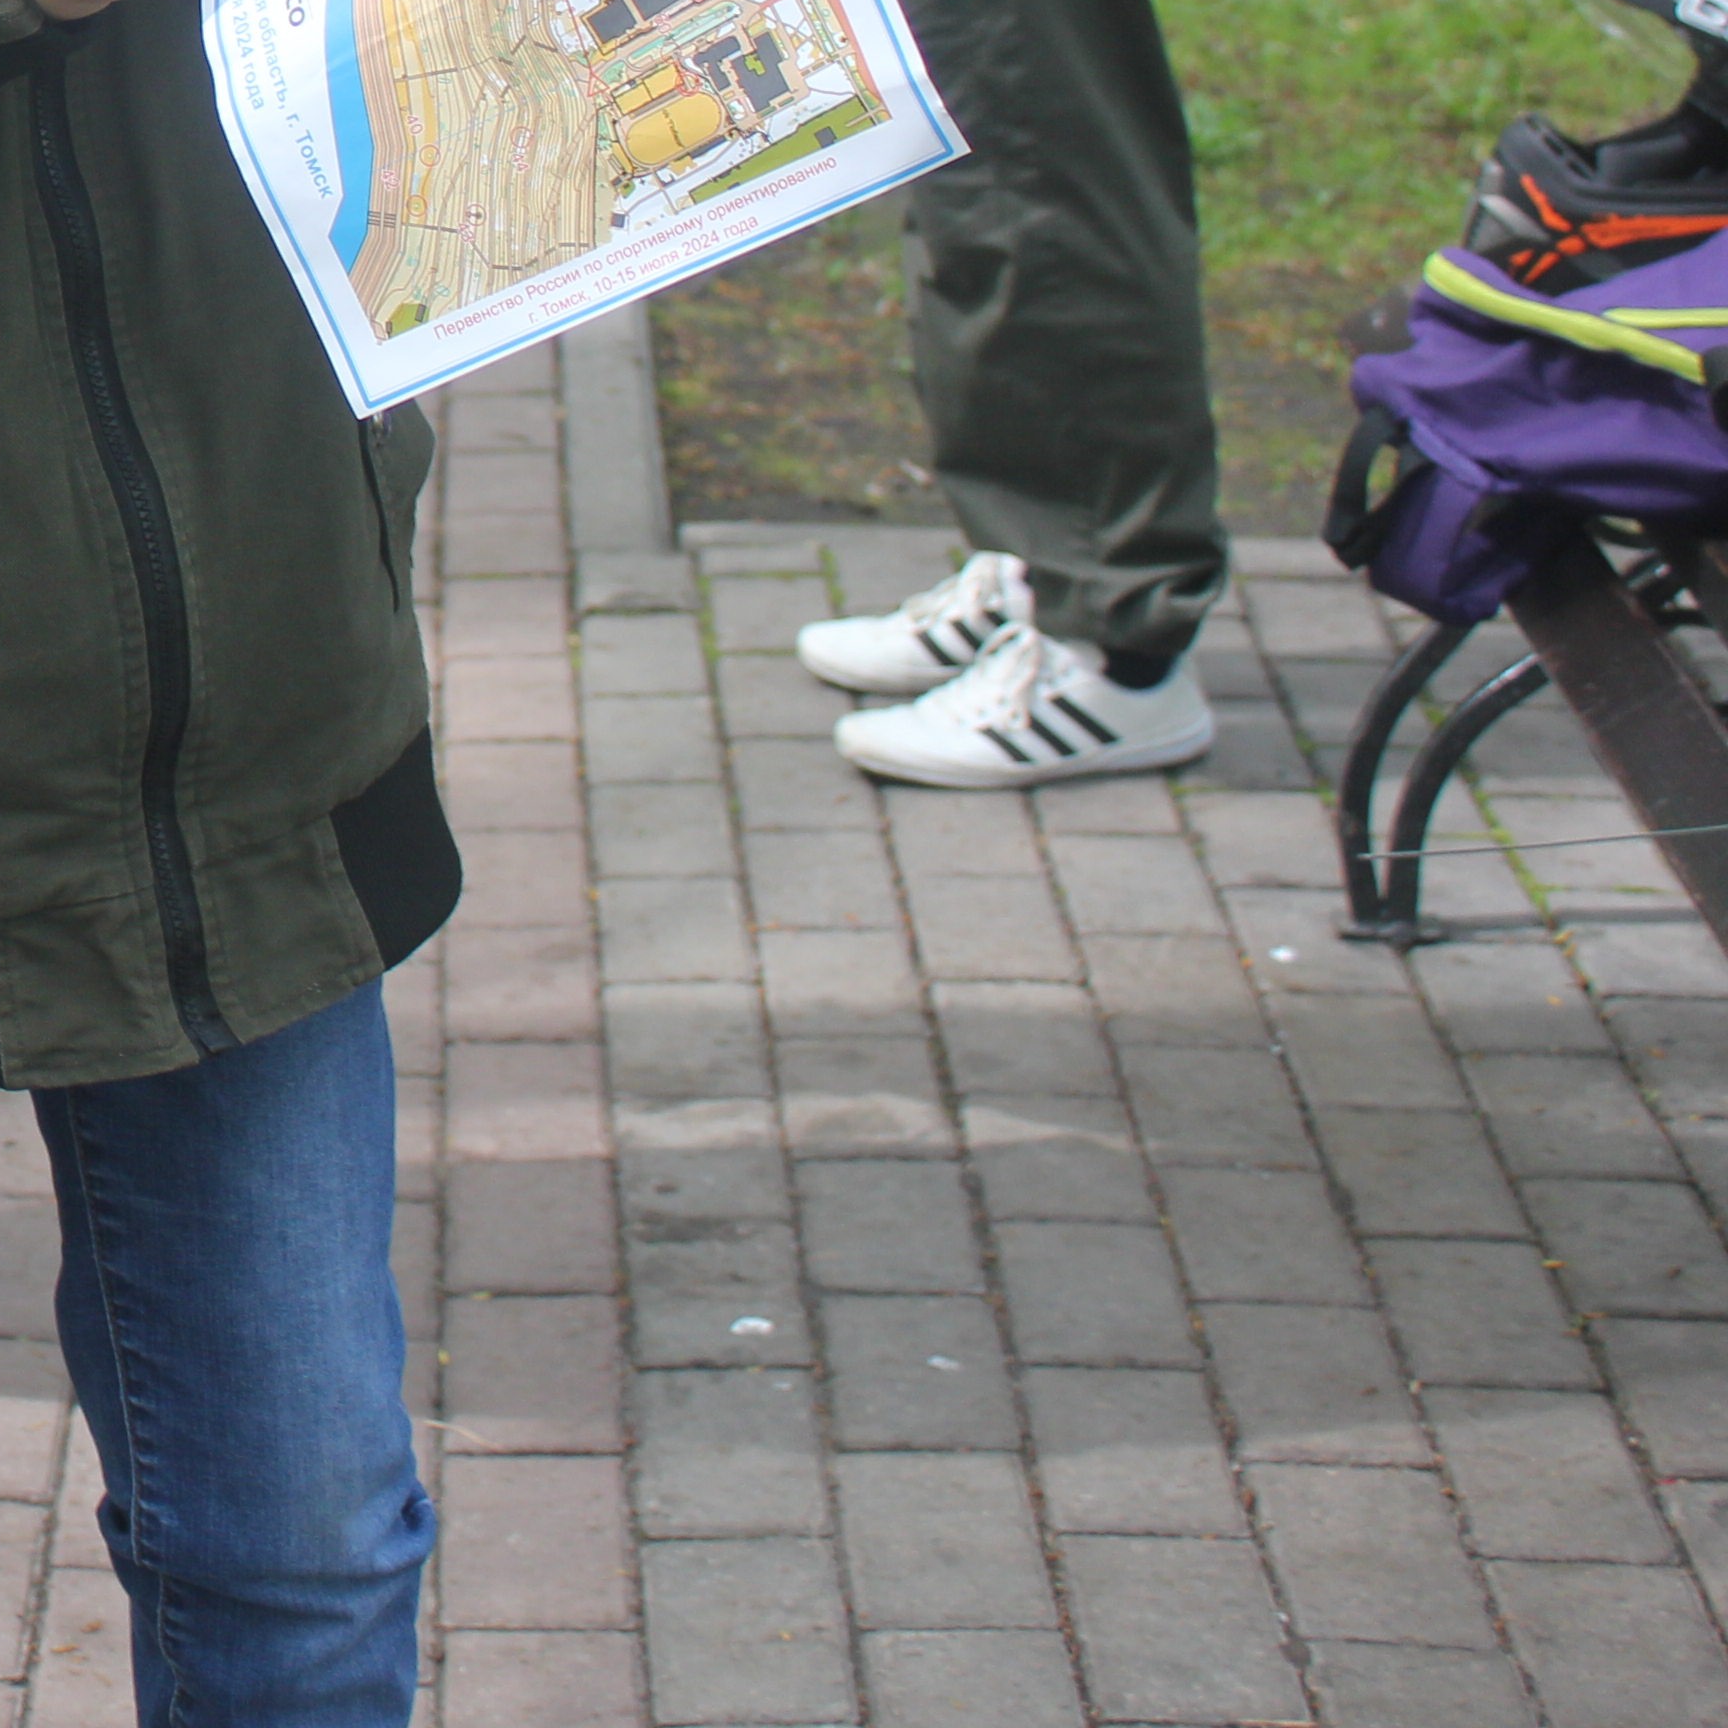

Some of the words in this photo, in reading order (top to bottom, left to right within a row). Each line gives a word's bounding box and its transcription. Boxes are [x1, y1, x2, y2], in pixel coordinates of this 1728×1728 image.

[232, 10, 254, 58] 2024
[242, 58, 266, 112] года
[406, 114, 424, 136] 40
[295, 128, 335, 200] Томск
[432, 292, 525, 341] Первенство
[523, 267, 583, 301] России
[582, 258, 604, 278] по
[605, 214, 705, 267] спортивному
[706, 155, 839, 223] ориентированию
[527, 311, 539, 326] г.
[539, 290, 592, 319] Томск,
[593, 266, 638, 297] 10-15
[639, 249, 682, 277] июля
[681, 229, 722, 258] 2024
[722, 214, 761, 241] года
